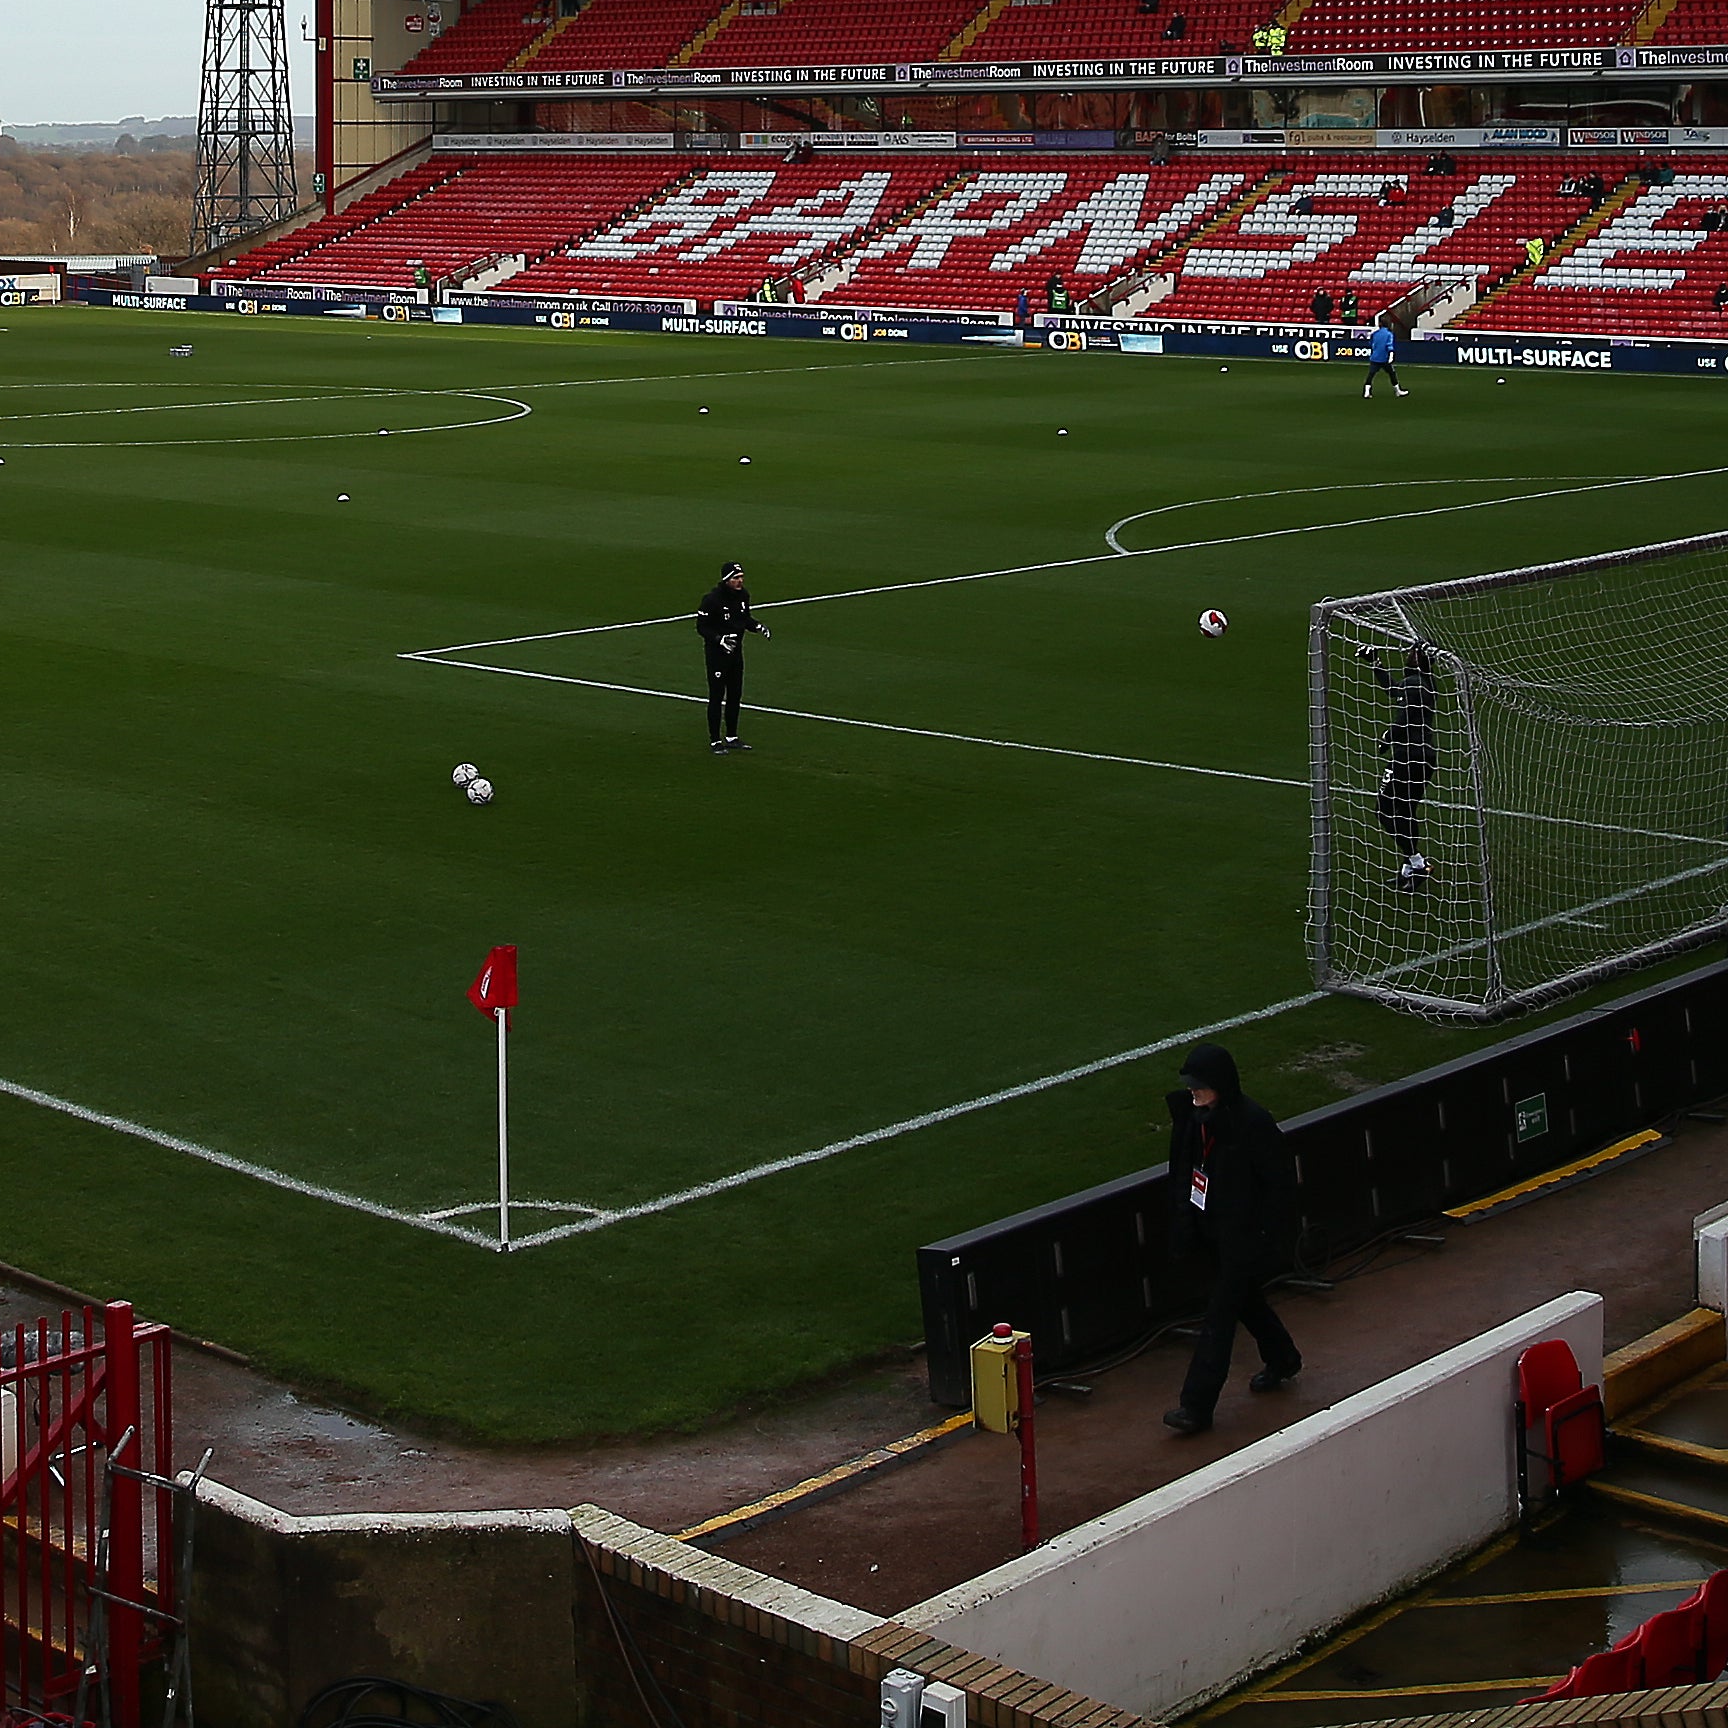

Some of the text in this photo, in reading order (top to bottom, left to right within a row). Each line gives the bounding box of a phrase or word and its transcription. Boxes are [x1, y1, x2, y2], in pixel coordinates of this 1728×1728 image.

[1033, 62, 1104, 78] INVESTING
[1110, 62, 1124, 75] IN
[1129, 61, 1157, 75] THE
[1161, 59, 1215, 74] FUTURE
[1388, 55, 1472, 71] INVESTING
[1478, 54, 1495, 69] IN
[1501, 53, 1534, 68] THE
[1540, 51, 1604, 67] FUTURE
[471, 76, 523, 87] INVESTING
[527, 75, 538, 86] IN
[541, 74, 562, 86] THE
[565, 74, 605, 86] FUTURE
[731, 70, 792, 83] INVESTING
[796, 70, 809, 81] IN
[813, 69, 837, 81] THE
[840, 68, 887, 81] FUTURE
[1164, 131, 1197, 141] for Bolts
[1406, 133, 1455, 146] Hayselden
[1571, 130, 1617, 144] WINDSOR
[1621, 130, 1669, 144] WINDSOR
[0, 290, 26, 306] OB1
[112, 294, 187, 311] MULTI-SURFACE
[238, 299, 258, 315] OB1
[383, 305, 410, 322] OB1
[591, 303, 611, 313] Call
[550, 312, 575, 329] OB1
[591, 317, 610, 326] DONE
[661, 317, 767, 336] MULTI-SURFACE
[822, 324, 909, 341] USE OB1 JOB DONE
[1048, 331, 1088, 351] OB1
[1271, 340, 1353, 360] USE OB1 JOB
[1457, 346, 1612, 369] MULTI-SURFACE
[1697, 357, 1717, 368] USE
